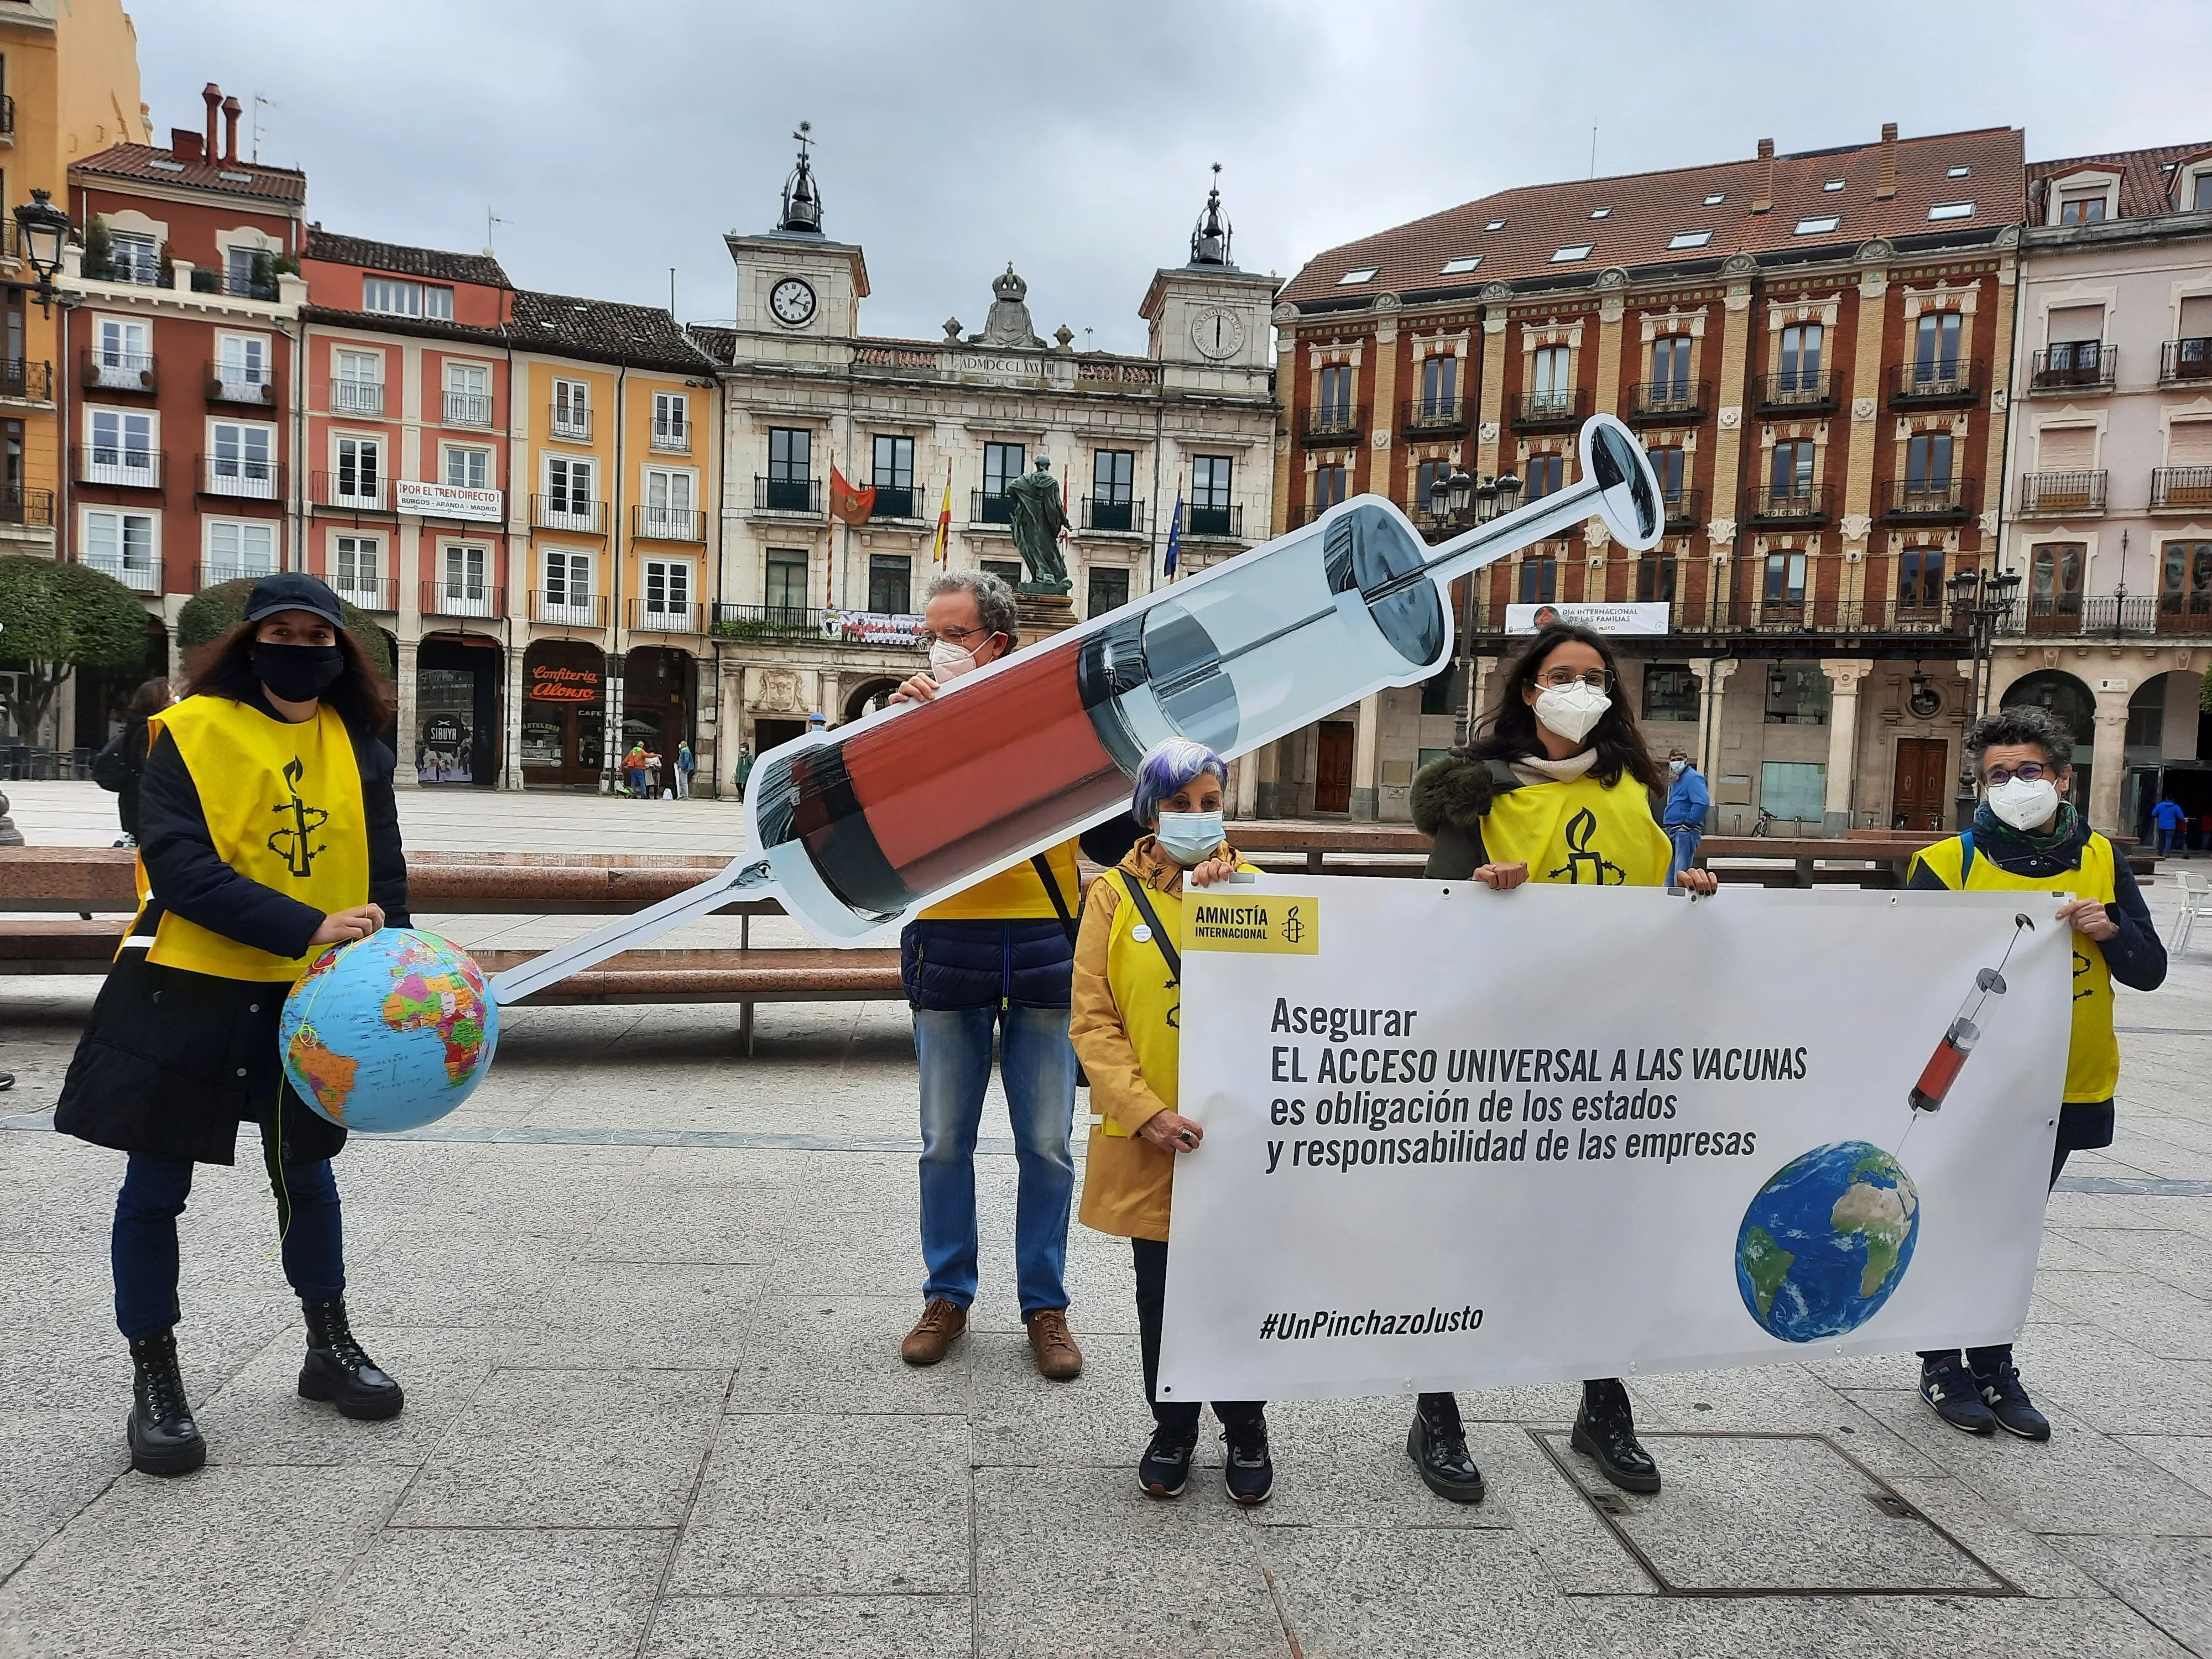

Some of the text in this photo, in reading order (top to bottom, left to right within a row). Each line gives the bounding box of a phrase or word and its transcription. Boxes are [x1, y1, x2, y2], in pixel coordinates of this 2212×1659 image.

[423, 486, 432, 496] EL
[434, 487, 456, 499] TREN
[458, 490, 495, 502] DIRECTO
[436, 500, 465, 509] ARANDA
[529, 682, 595, 701] Alonso
[431, 727, 457, 740] SIBUYA
[522, 723, 560, 732] ASTELERIA
[1195, 904, 1268, 926] AMNISTÍA
[1195, 926, 1267, 940] INTERNACIONAL
[1270, 997, 1417, 1043] Asegurar
[1272, 1046, 1808, 1084] EL ACCESO UNIVERSAL A LAS VACUNAS
[1271, 1087, 1677, 1131] es obligación de los estados
[1265, 1128, 1757, 1175] y responsabilidad de las empresas
[1260, 1305, 1484, 1340] #UnPinchazoJusto
